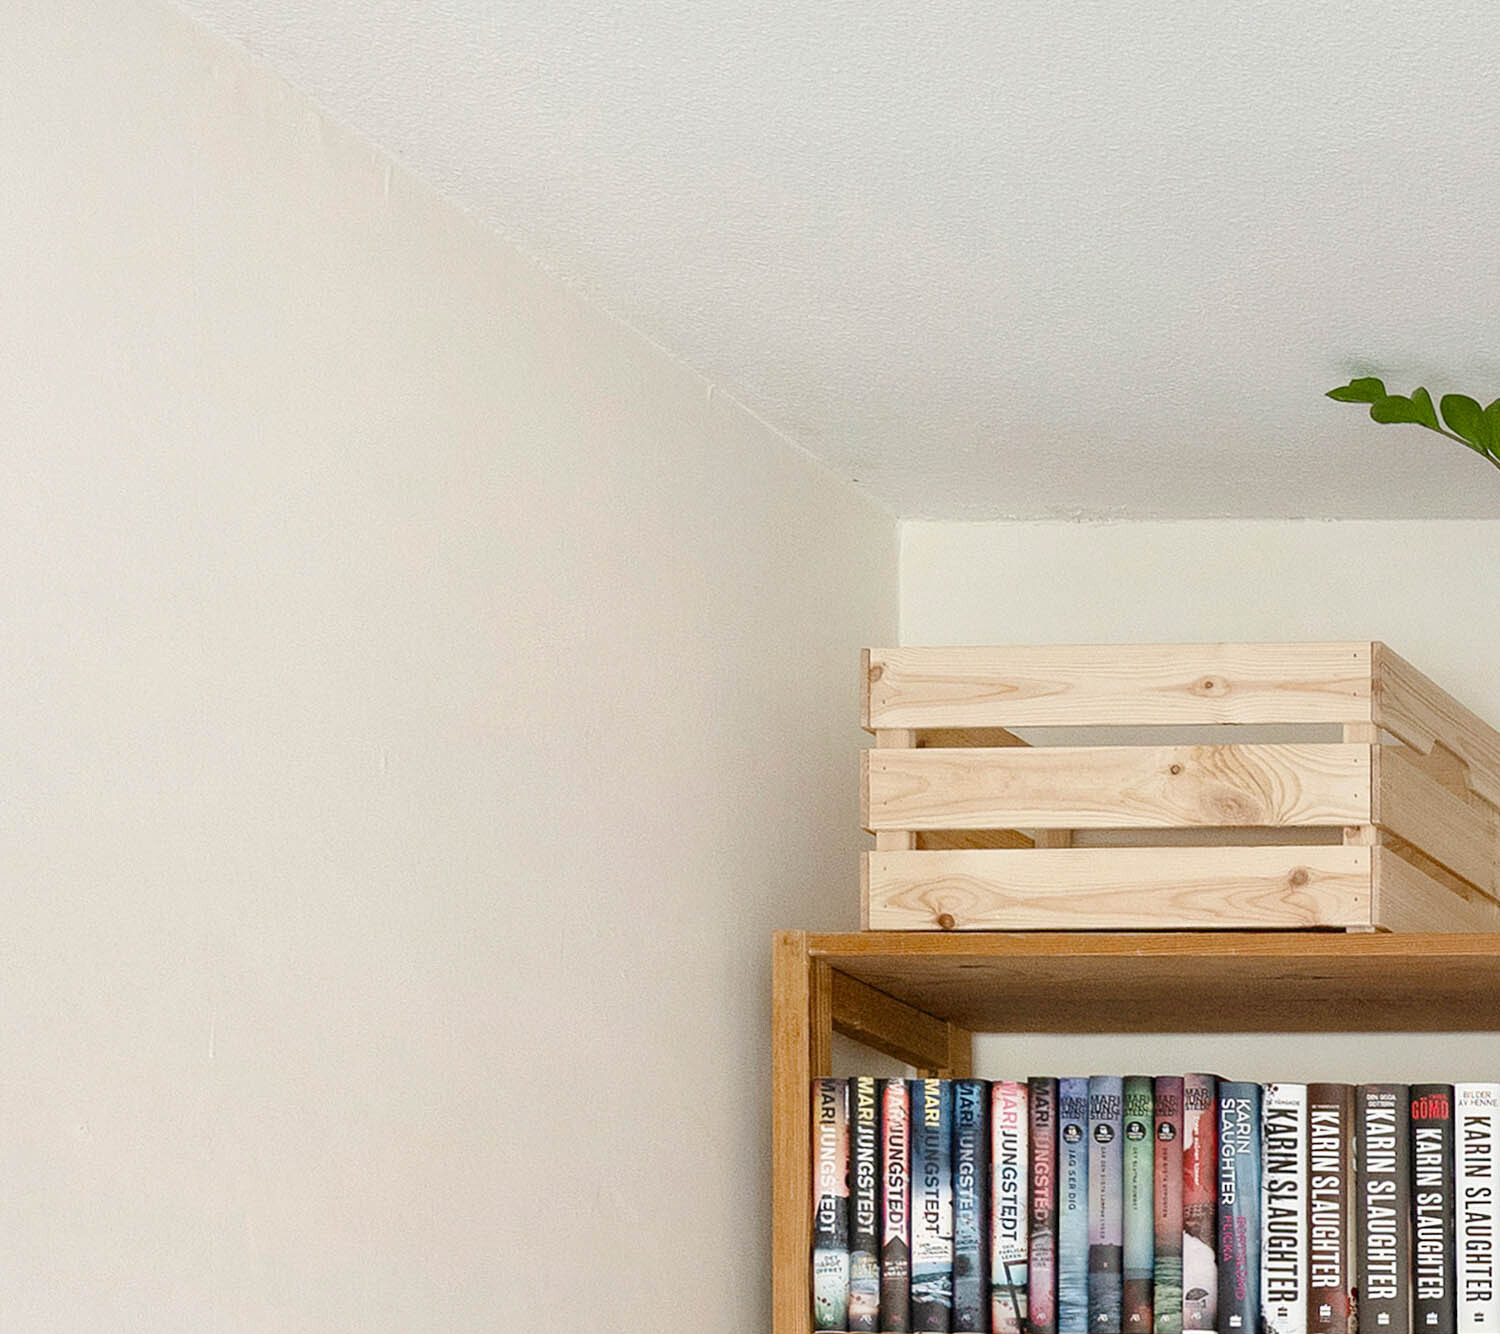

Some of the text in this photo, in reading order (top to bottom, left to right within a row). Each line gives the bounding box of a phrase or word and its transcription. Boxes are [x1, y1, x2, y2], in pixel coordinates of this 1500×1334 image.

[857, 1126, 873, 1235] JUNGSTEDT
[924, 1127, 940, 1234] JUNGSTEDT
[1221, 1099, 1235, 1205] SLAUGHTER
[1236, 1099, 1251, 1155] KARIN
[1268, 1109, 1298, 1303] KARIN SLAUGHTER
[1311, 1113, 1340, 1288] KARIN SLAUGHTER
[1367, 1109, 1397, 1300] KARIN SLAUGHTER
